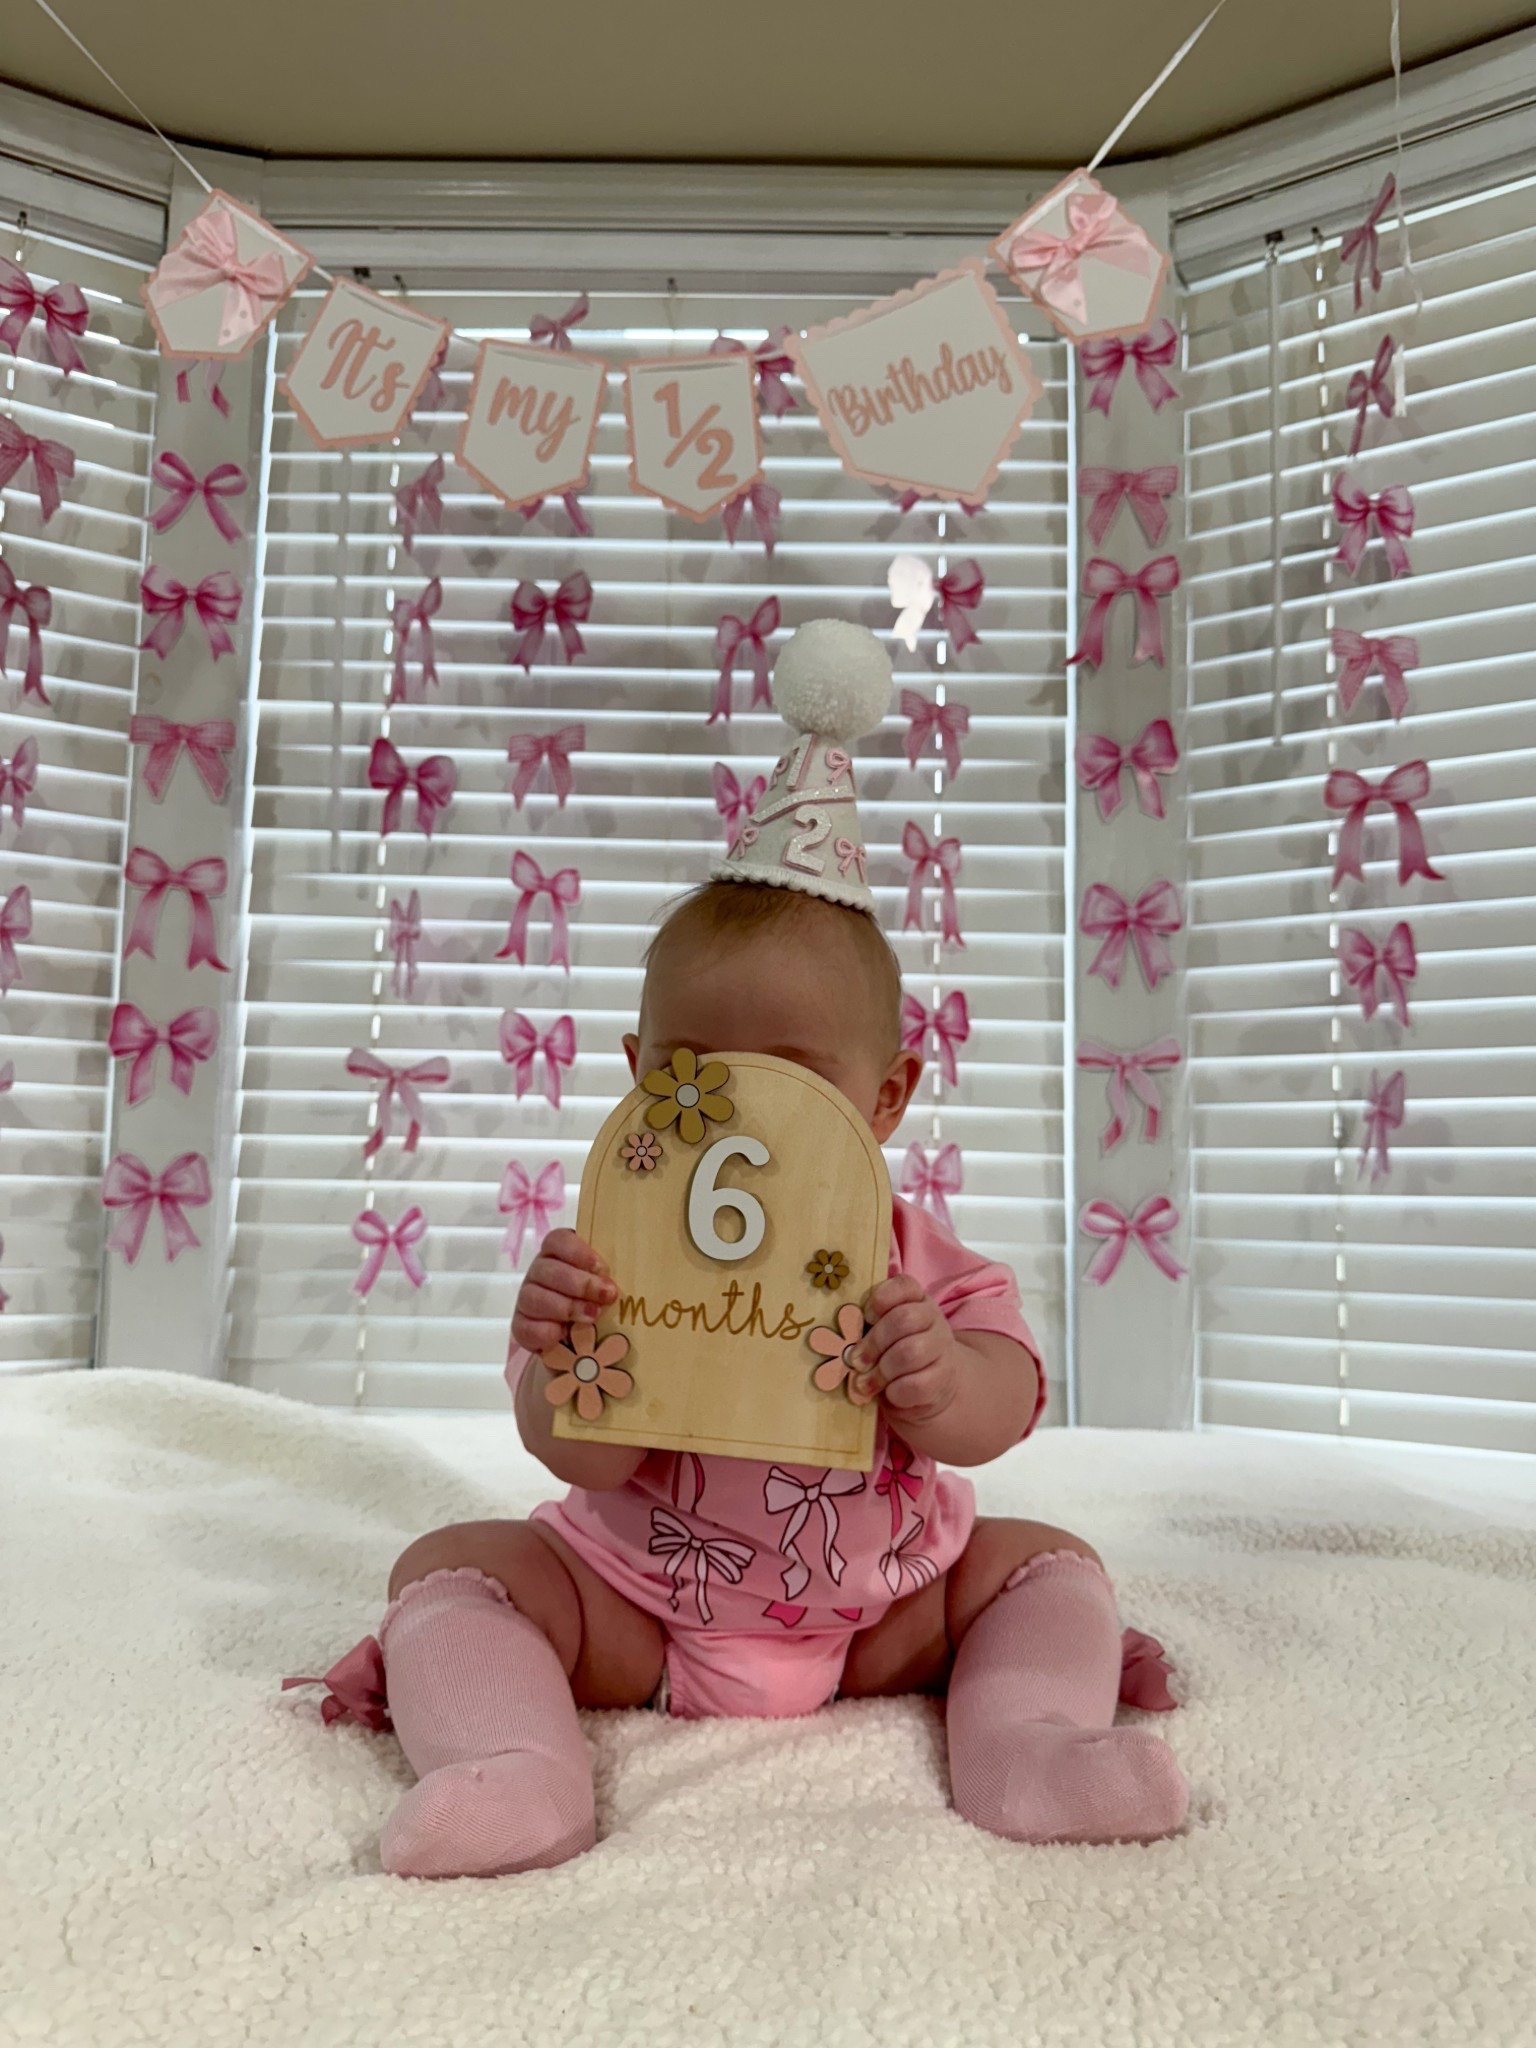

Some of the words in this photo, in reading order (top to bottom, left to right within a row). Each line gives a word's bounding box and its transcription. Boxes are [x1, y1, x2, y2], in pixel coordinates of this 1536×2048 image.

[487, 376, 580, 463] my
[827, 342, 1012, 438] Birthday
[689, 1136, 770, 1260] 6
[618, 1280, 815, 1340] months
